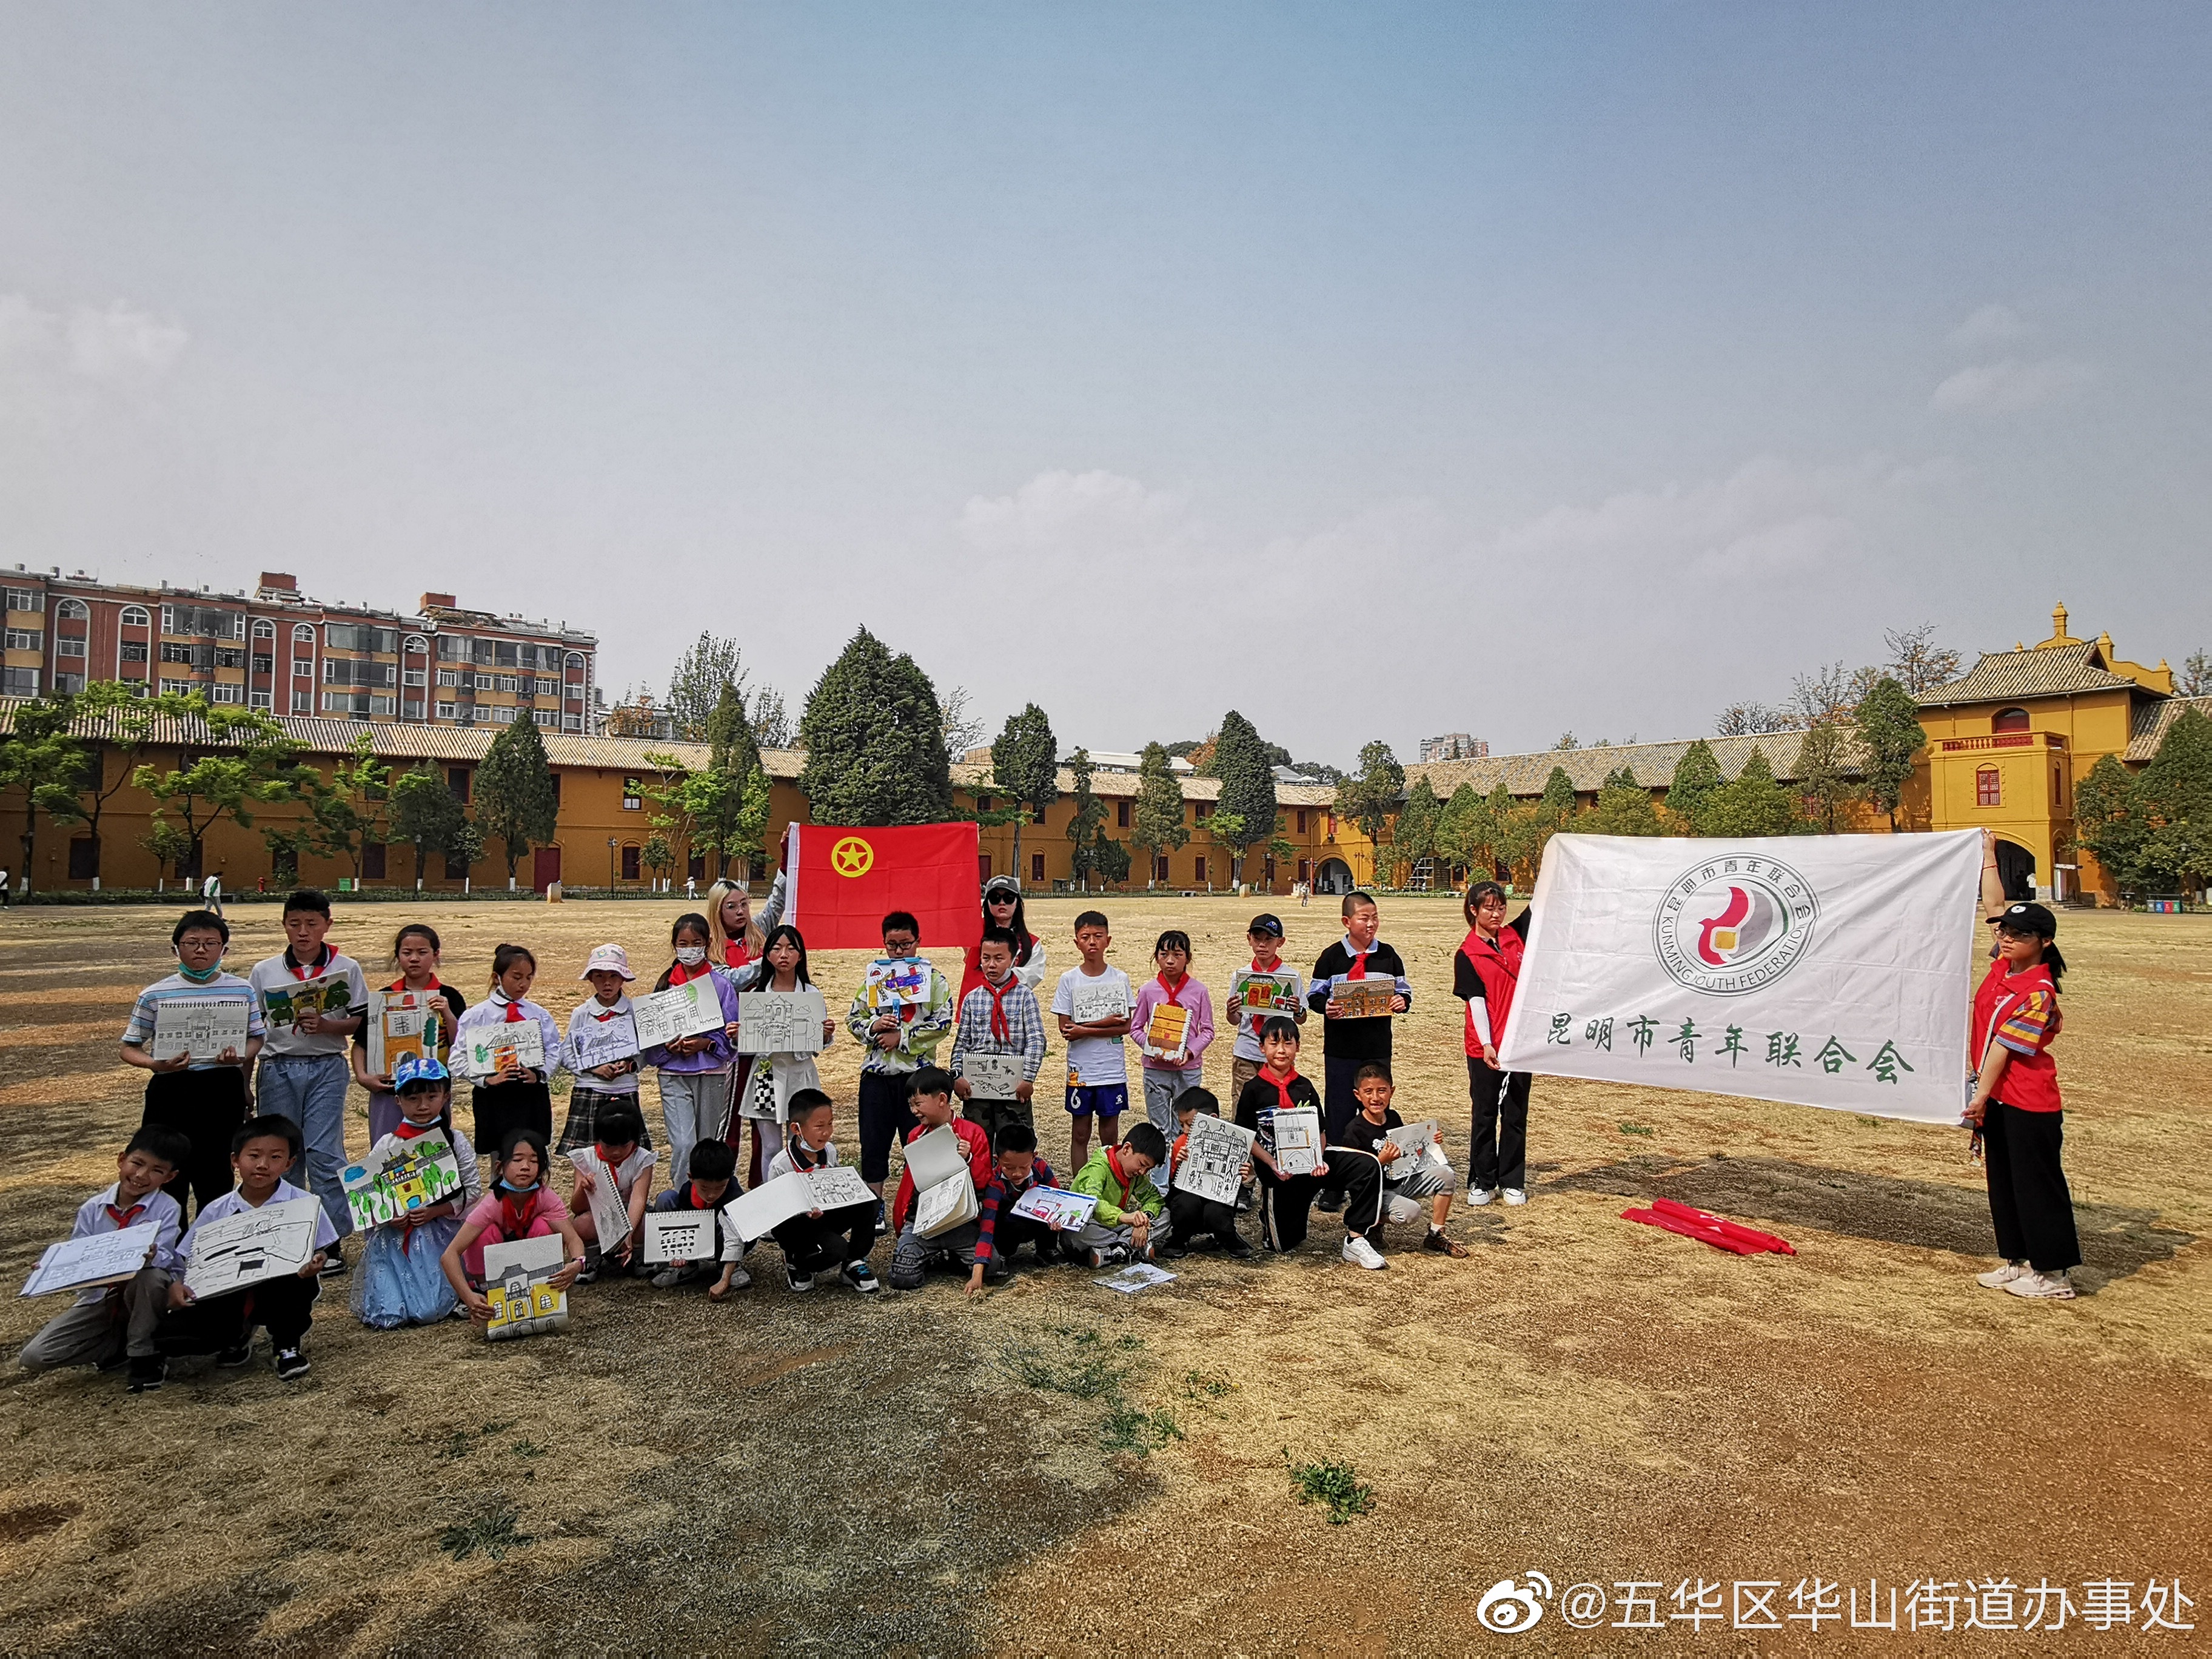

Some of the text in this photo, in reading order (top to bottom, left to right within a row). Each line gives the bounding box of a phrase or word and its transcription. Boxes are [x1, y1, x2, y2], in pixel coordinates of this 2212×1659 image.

[1666, 860, 1811, 919] 昆明市青年联合会
[1661, 916, 1694, 980] KUNMING
[1547, 1013, 1915, 1085] 昆明市青年联合会
[1070, 1088, 1081, 1109] 6
